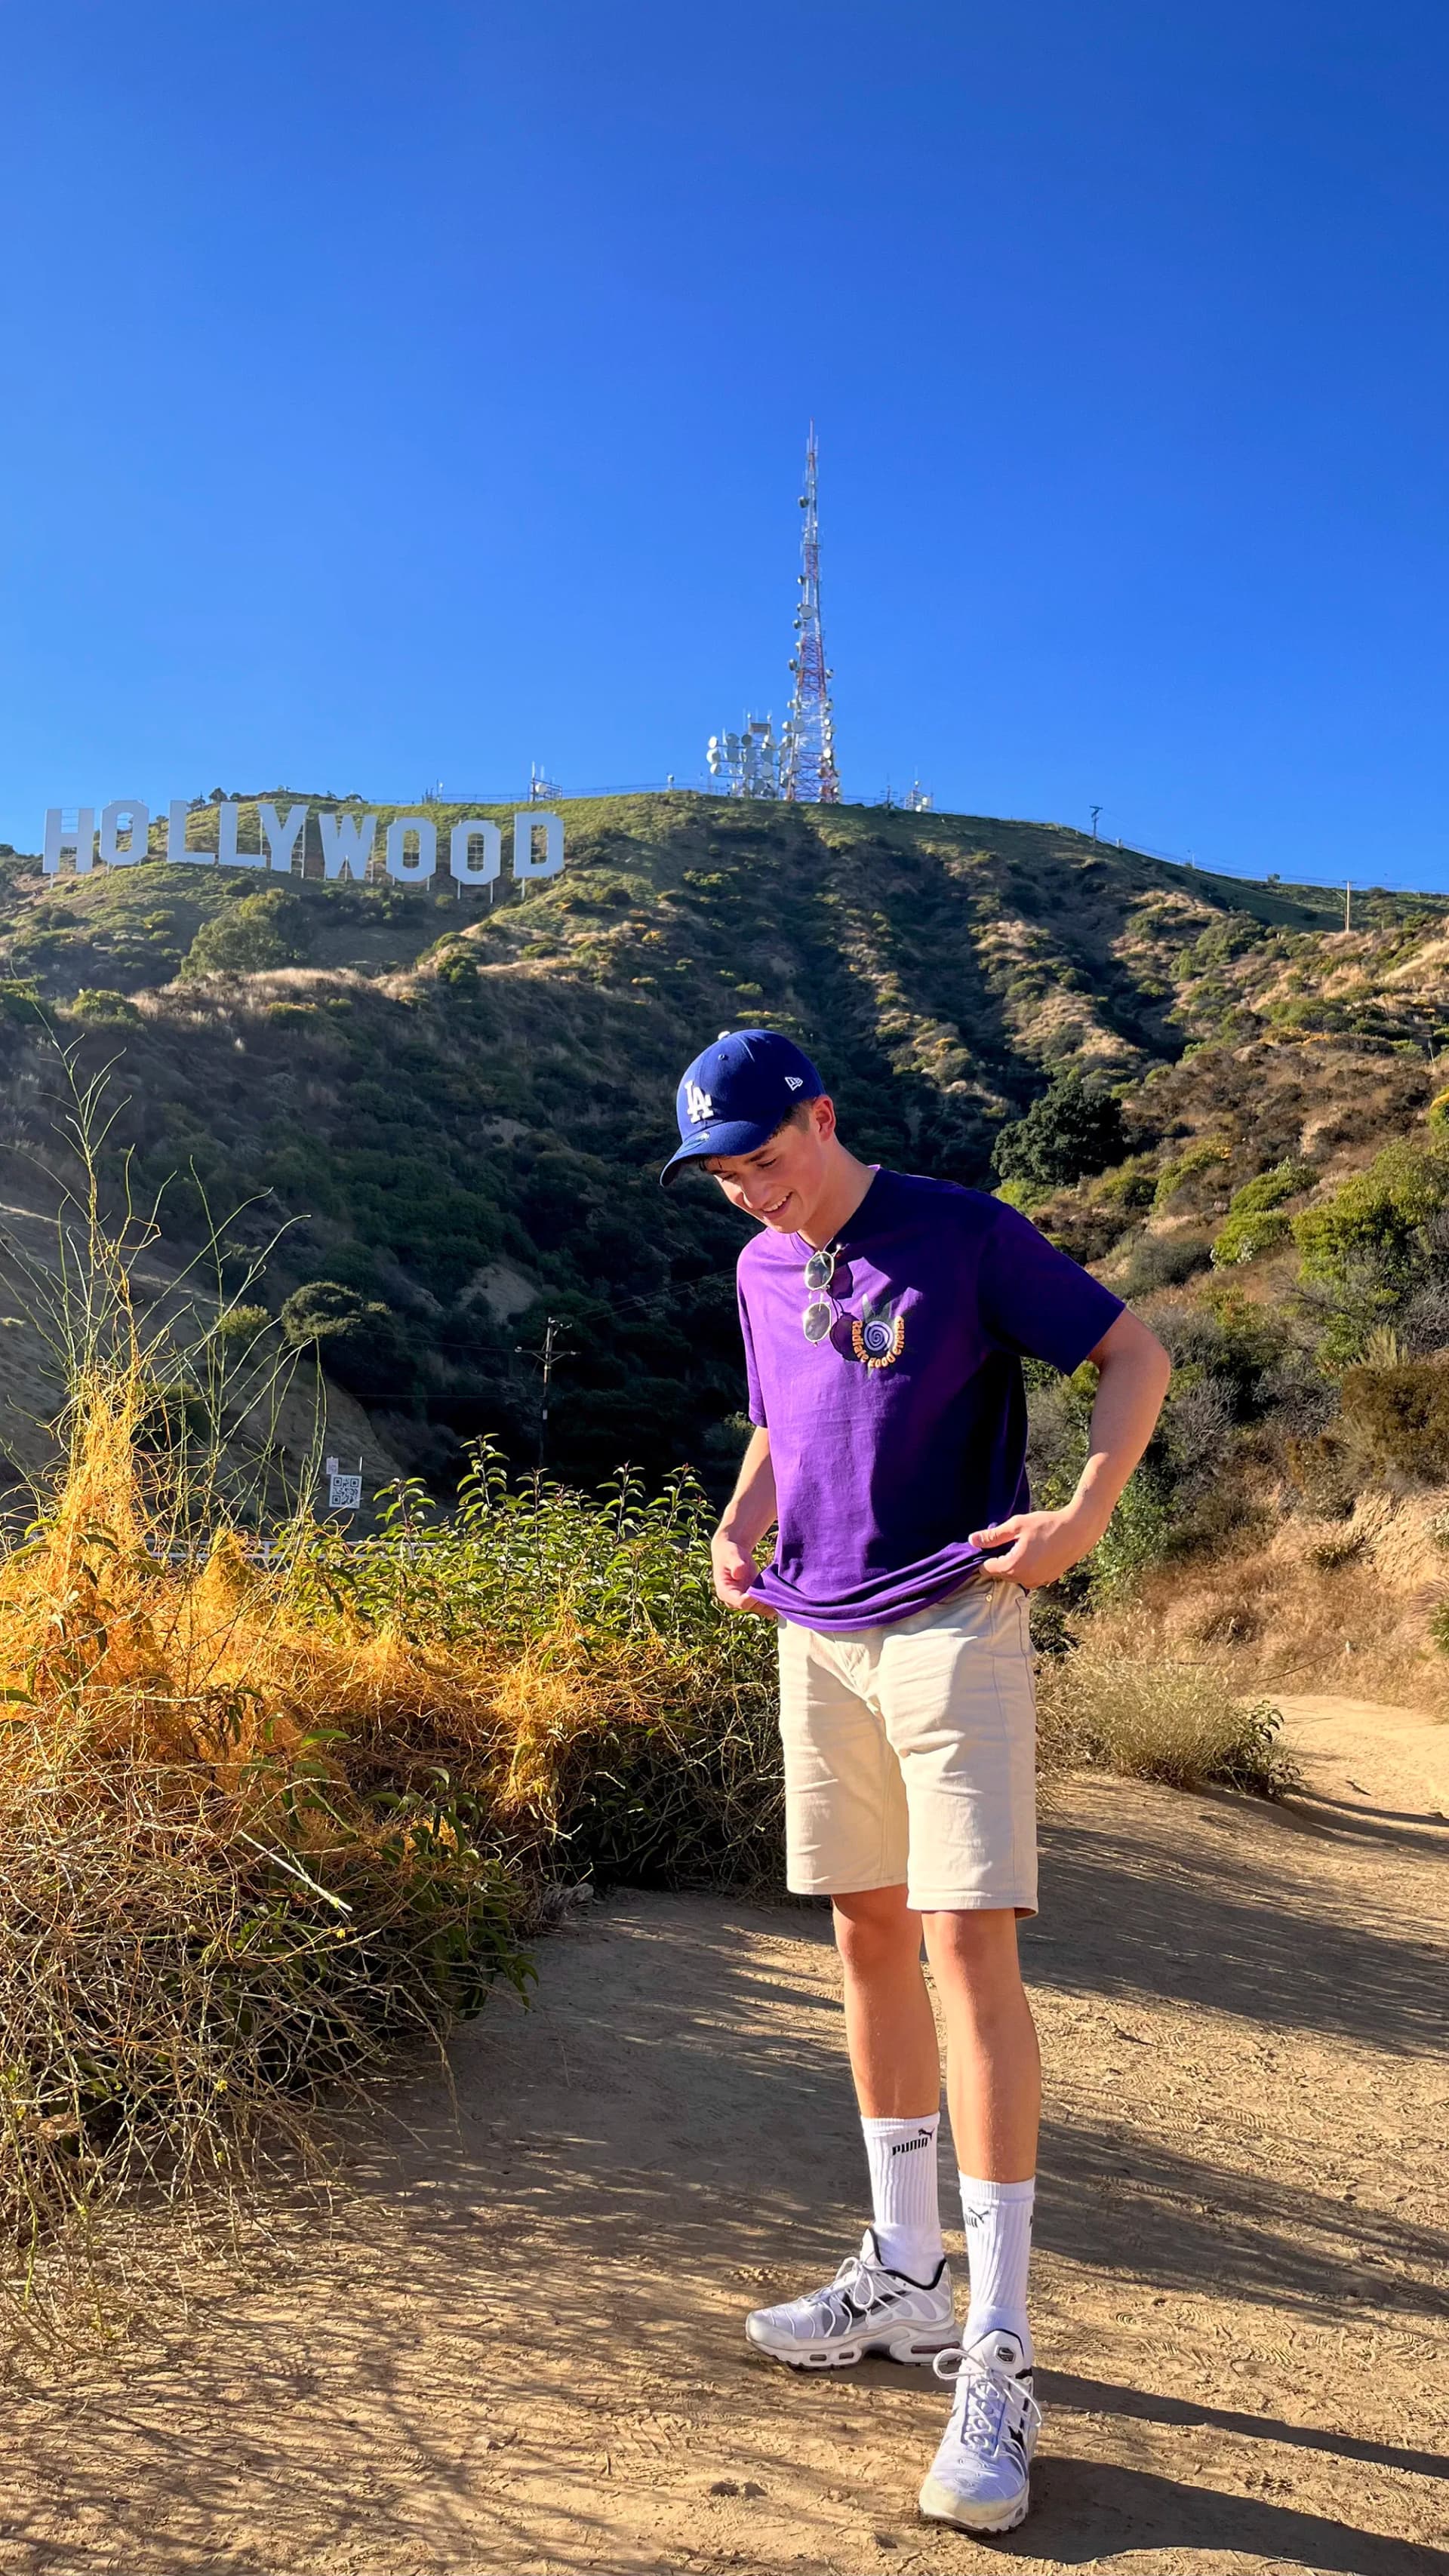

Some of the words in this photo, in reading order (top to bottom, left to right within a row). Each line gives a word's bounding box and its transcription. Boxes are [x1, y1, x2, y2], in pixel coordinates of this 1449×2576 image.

[42, 800, 565, 885] HOLLYWOOD
[684, 1080, 715, 1124] LA
[852, 1320, 869, 1363] Radiate
[867, 1351, 896, 1368] good
[892, 2137, 928, 2156] PUMA
